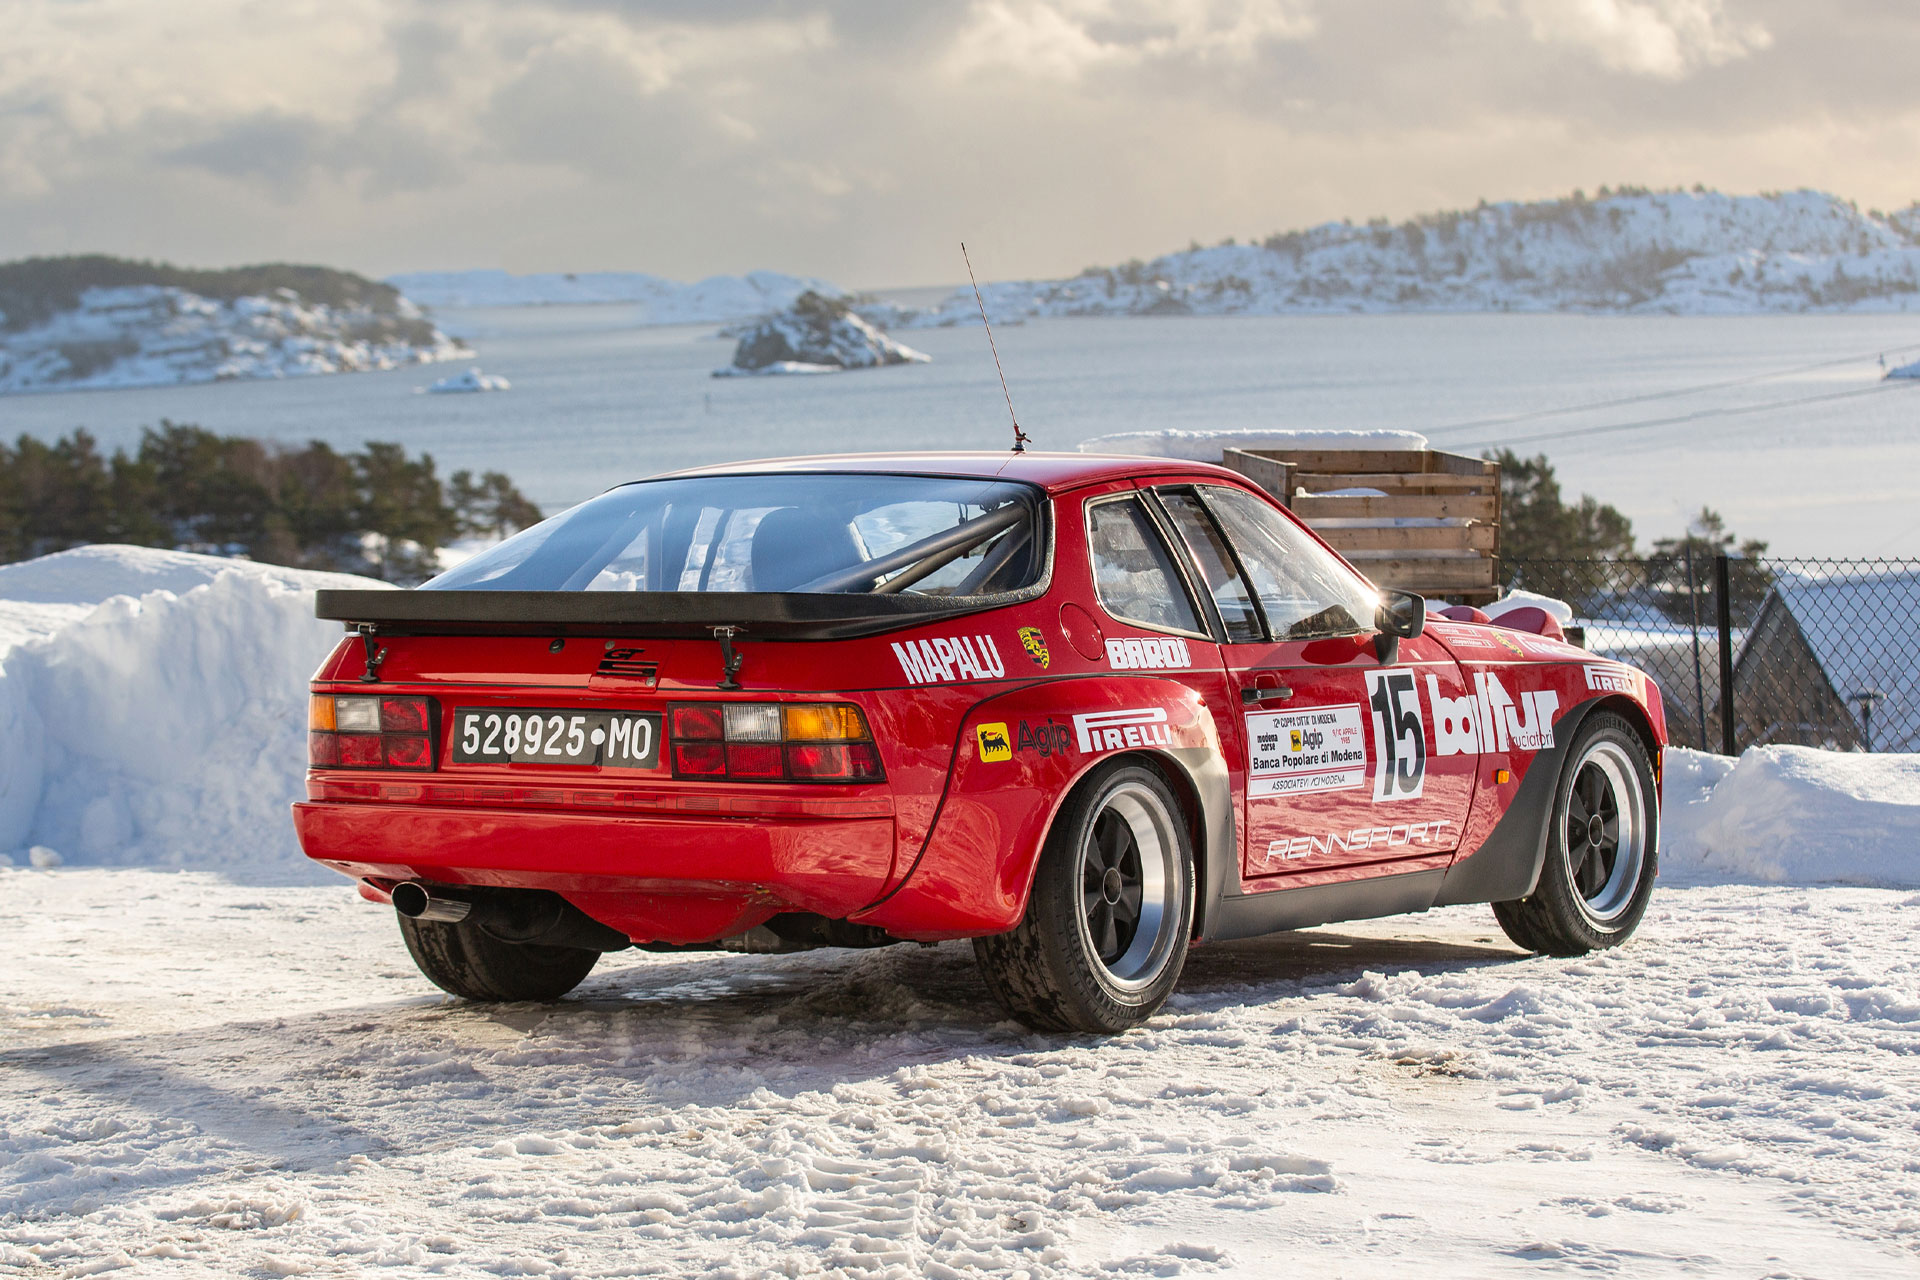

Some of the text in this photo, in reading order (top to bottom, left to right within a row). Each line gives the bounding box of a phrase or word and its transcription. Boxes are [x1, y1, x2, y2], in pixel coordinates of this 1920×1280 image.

[890, 635, 1005, 685] MAPALU
[1104, 637, 1191, 669] BARDI
[1311, 715, 1317, 725] DI
[1317, 713, 1337, 724] MODENA
[1425, 672, 1560, 756] baltur
[1017, 718, 1071, 757] Agip
[1072, 707, 1173, 753] PIRELLI
[1257, 732, 1278, 743] modena
[1302, 727, 1324, 750] Agip
[1342, 727, 1357, 736] APRILE
[1371, 674, 1426, 797] 15
[1260, 741, 1276, 752] corse
[1253, 750, 1363, 770] Banca Popolare di Modena
[1321, 774, 1345, 786] MODENA
[379, 786, 720, 811] PORSCHE
[1265, 819, 1450, 862] RENNSPORT
